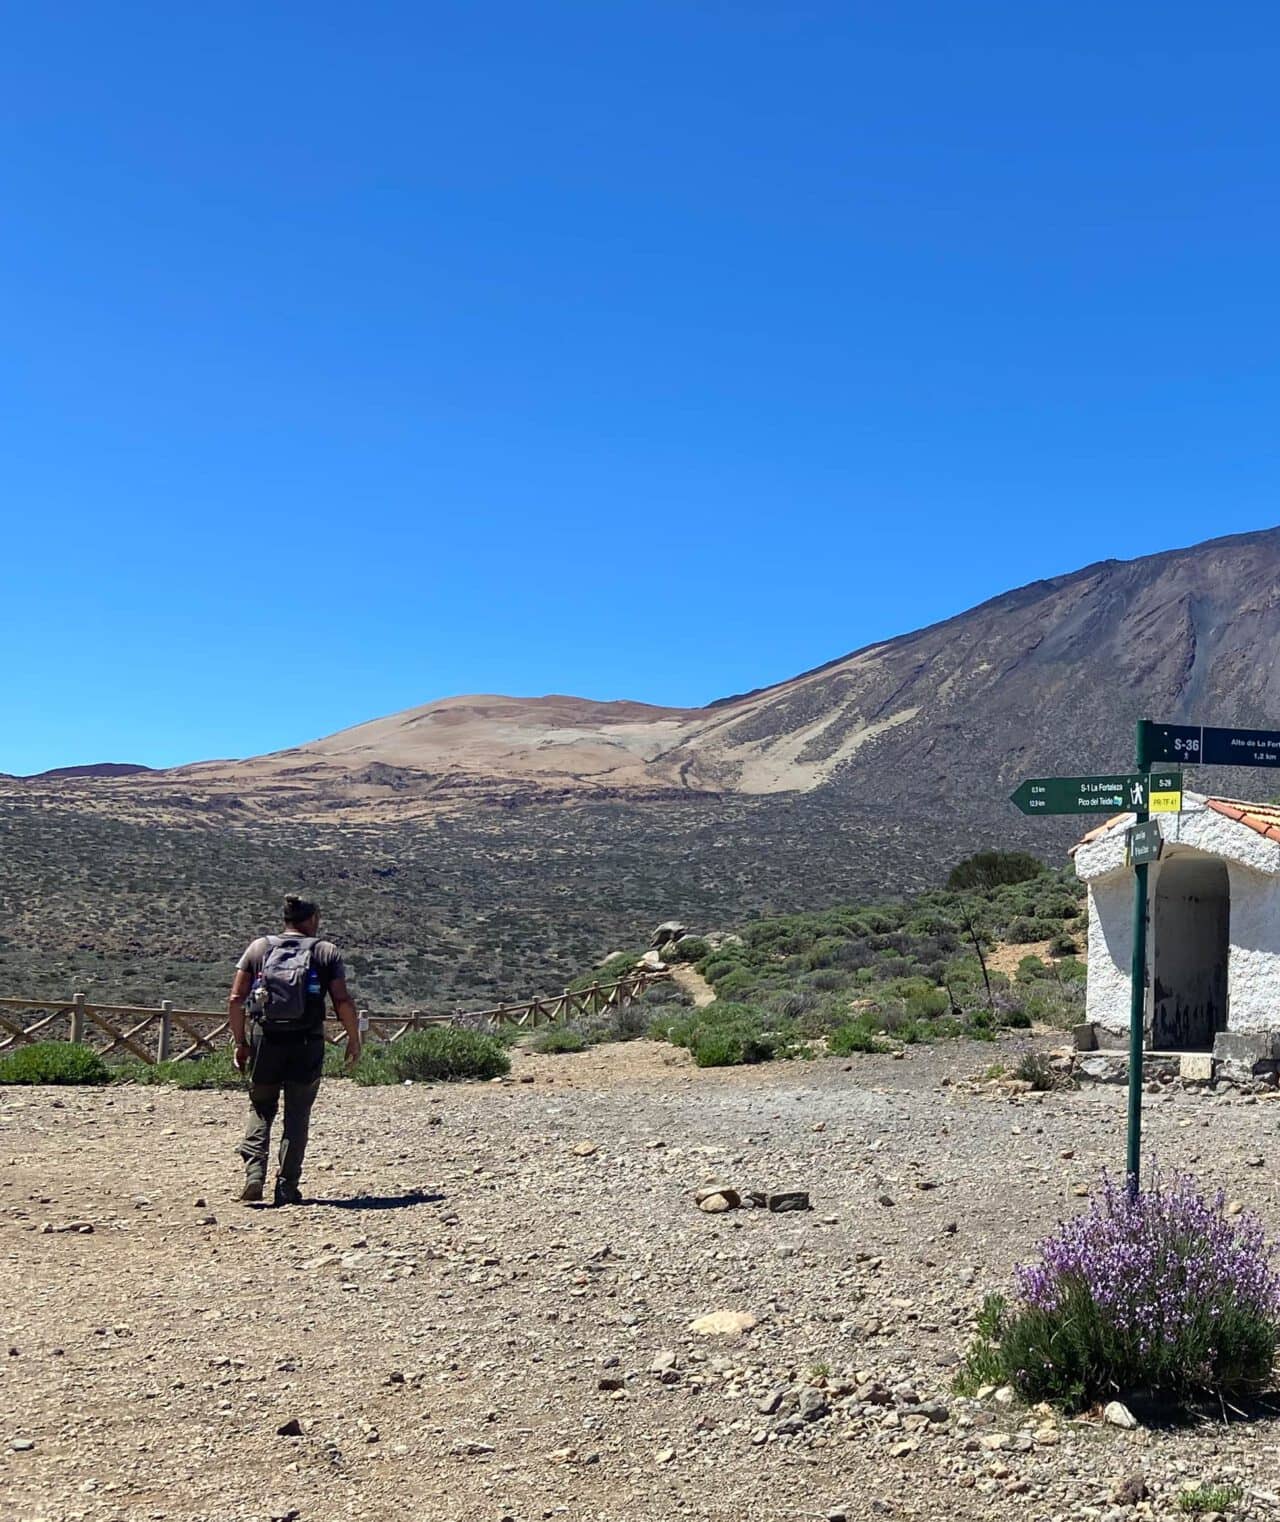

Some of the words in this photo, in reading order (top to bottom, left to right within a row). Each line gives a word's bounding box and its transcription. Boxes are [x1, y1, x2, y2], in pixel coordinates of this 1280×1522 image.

[1174, 738, 1200, 752] S-36
[1231, 738, 1246, 747] Alto
[1246, 739, 1256, 747] de
[1090, 783, 1098, 792] La
[1098, 783, 1123, 792] Fortaleza
[1078, 797, 1090, 806] Pico
[1090, 797, 1098, 806] del
[1098, 796, 1113, 805] Teide
